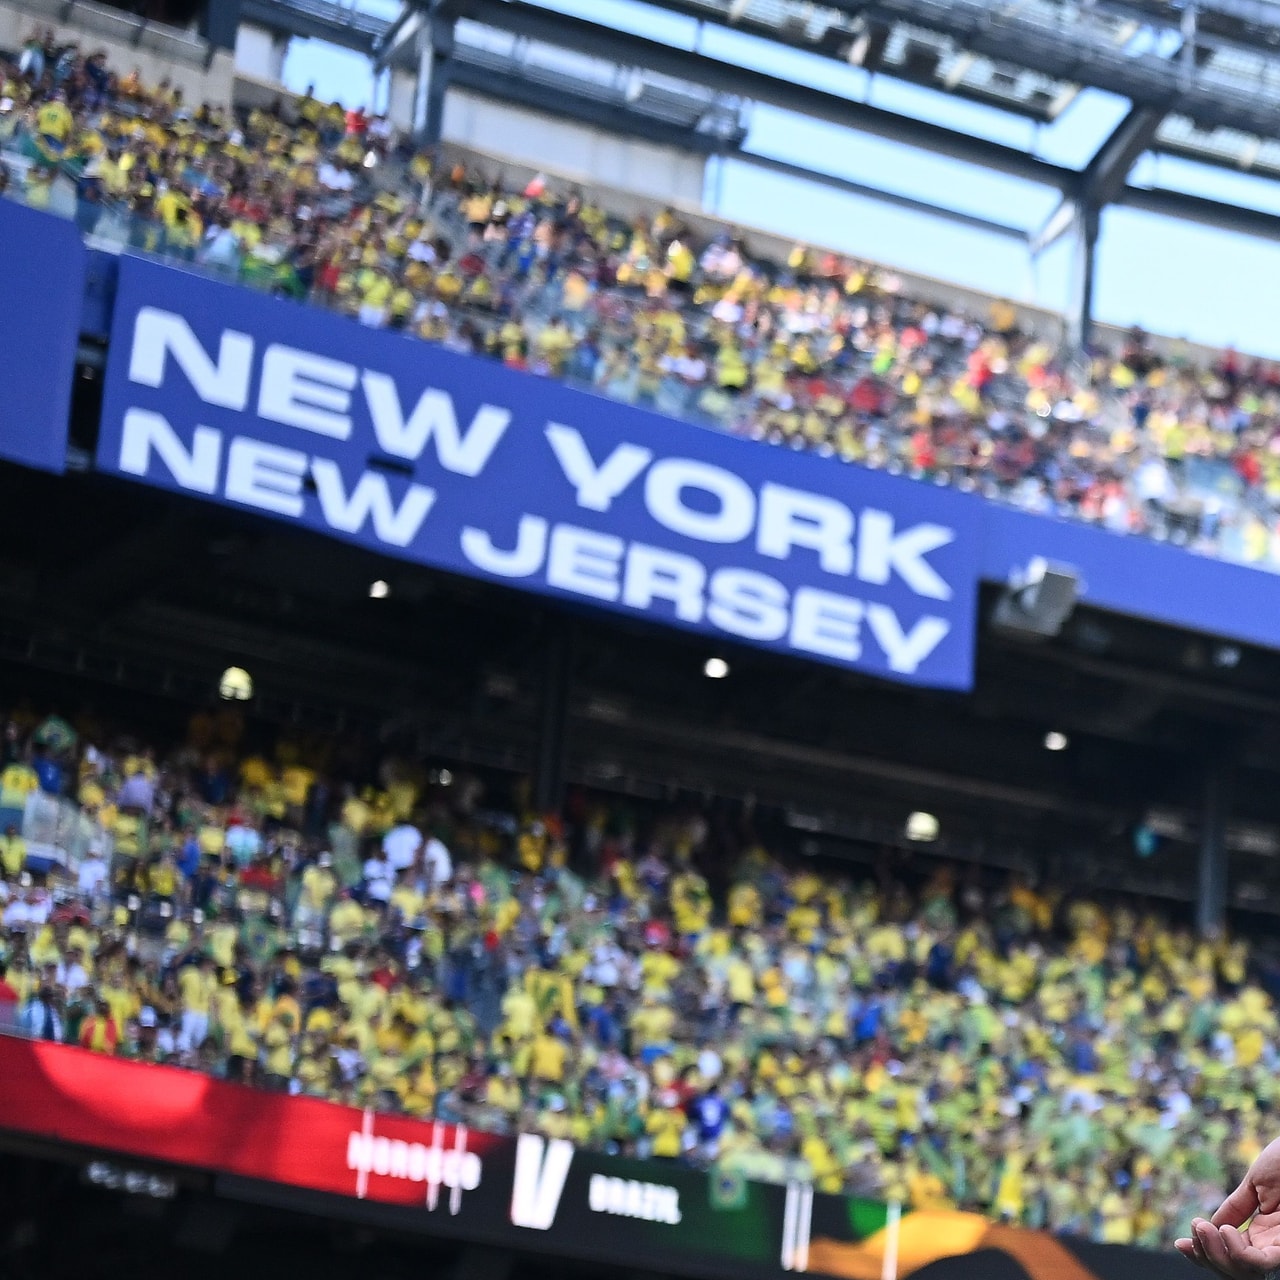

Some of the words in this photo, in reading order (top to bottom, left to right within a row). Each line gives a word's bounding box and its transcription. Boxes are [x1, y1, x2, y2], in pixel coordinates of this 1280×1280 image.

[118, 406, 437, 549] NEW
[460, 513, 952, 675] JERSEY
[127, 305, 511, 478] NEW
[545, 420, 957, 600] YORK
[510, 1132, 575, 1231] V
